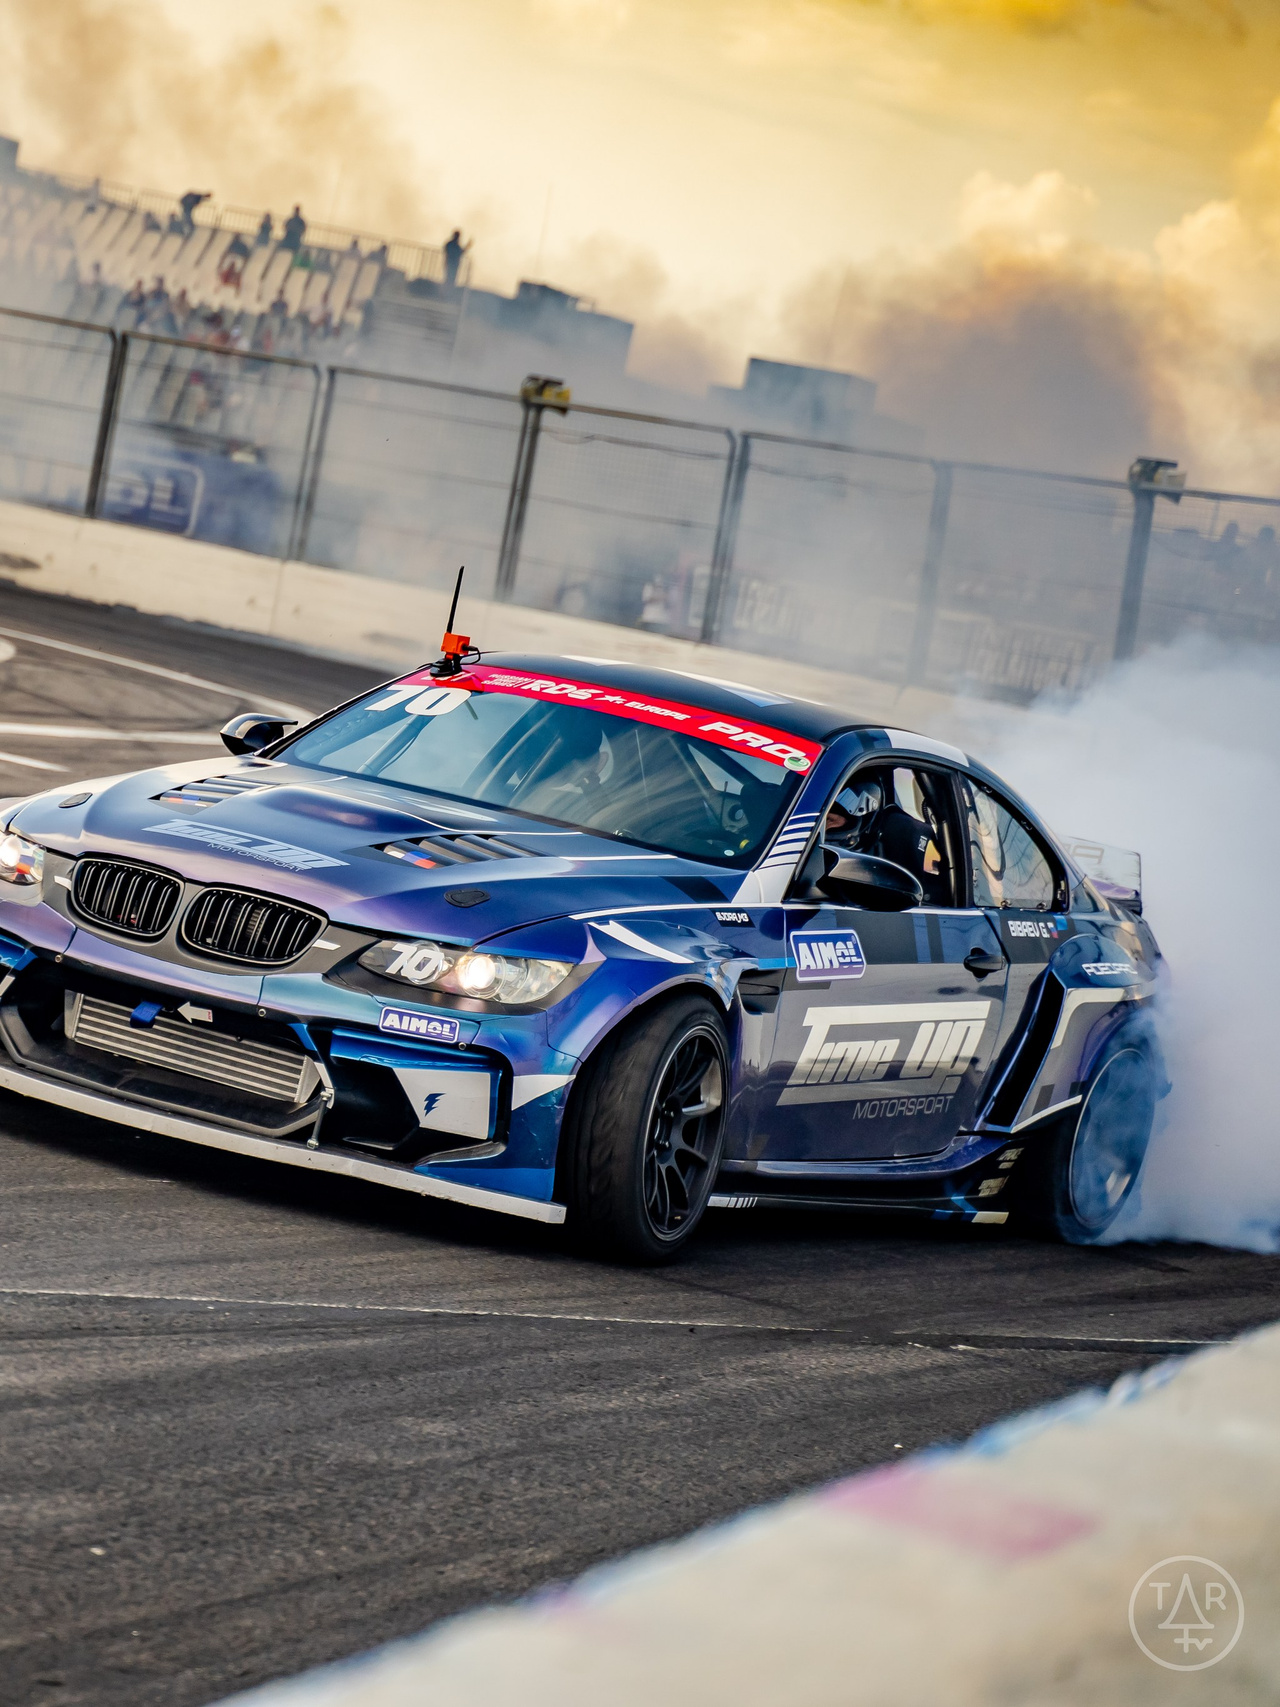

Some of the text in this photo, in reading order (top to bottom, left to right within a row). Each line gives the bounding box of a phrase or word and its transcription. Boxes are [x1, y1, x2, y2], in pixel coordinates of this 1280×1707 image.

[364, 684, 472, 716] 70
[521, 679, 692, 721] RDS EUROPE
[698, 721, 807, 760] PRO
[208, 842, 306, 872] MOTORSPORT
[385, 944, 445, 980] 70
[797, 939, 863, 970] AIMOL
[382, 1013, 455, 1039] AIMOL
[852, 1095, 955, 1120] MOTORSPORT
